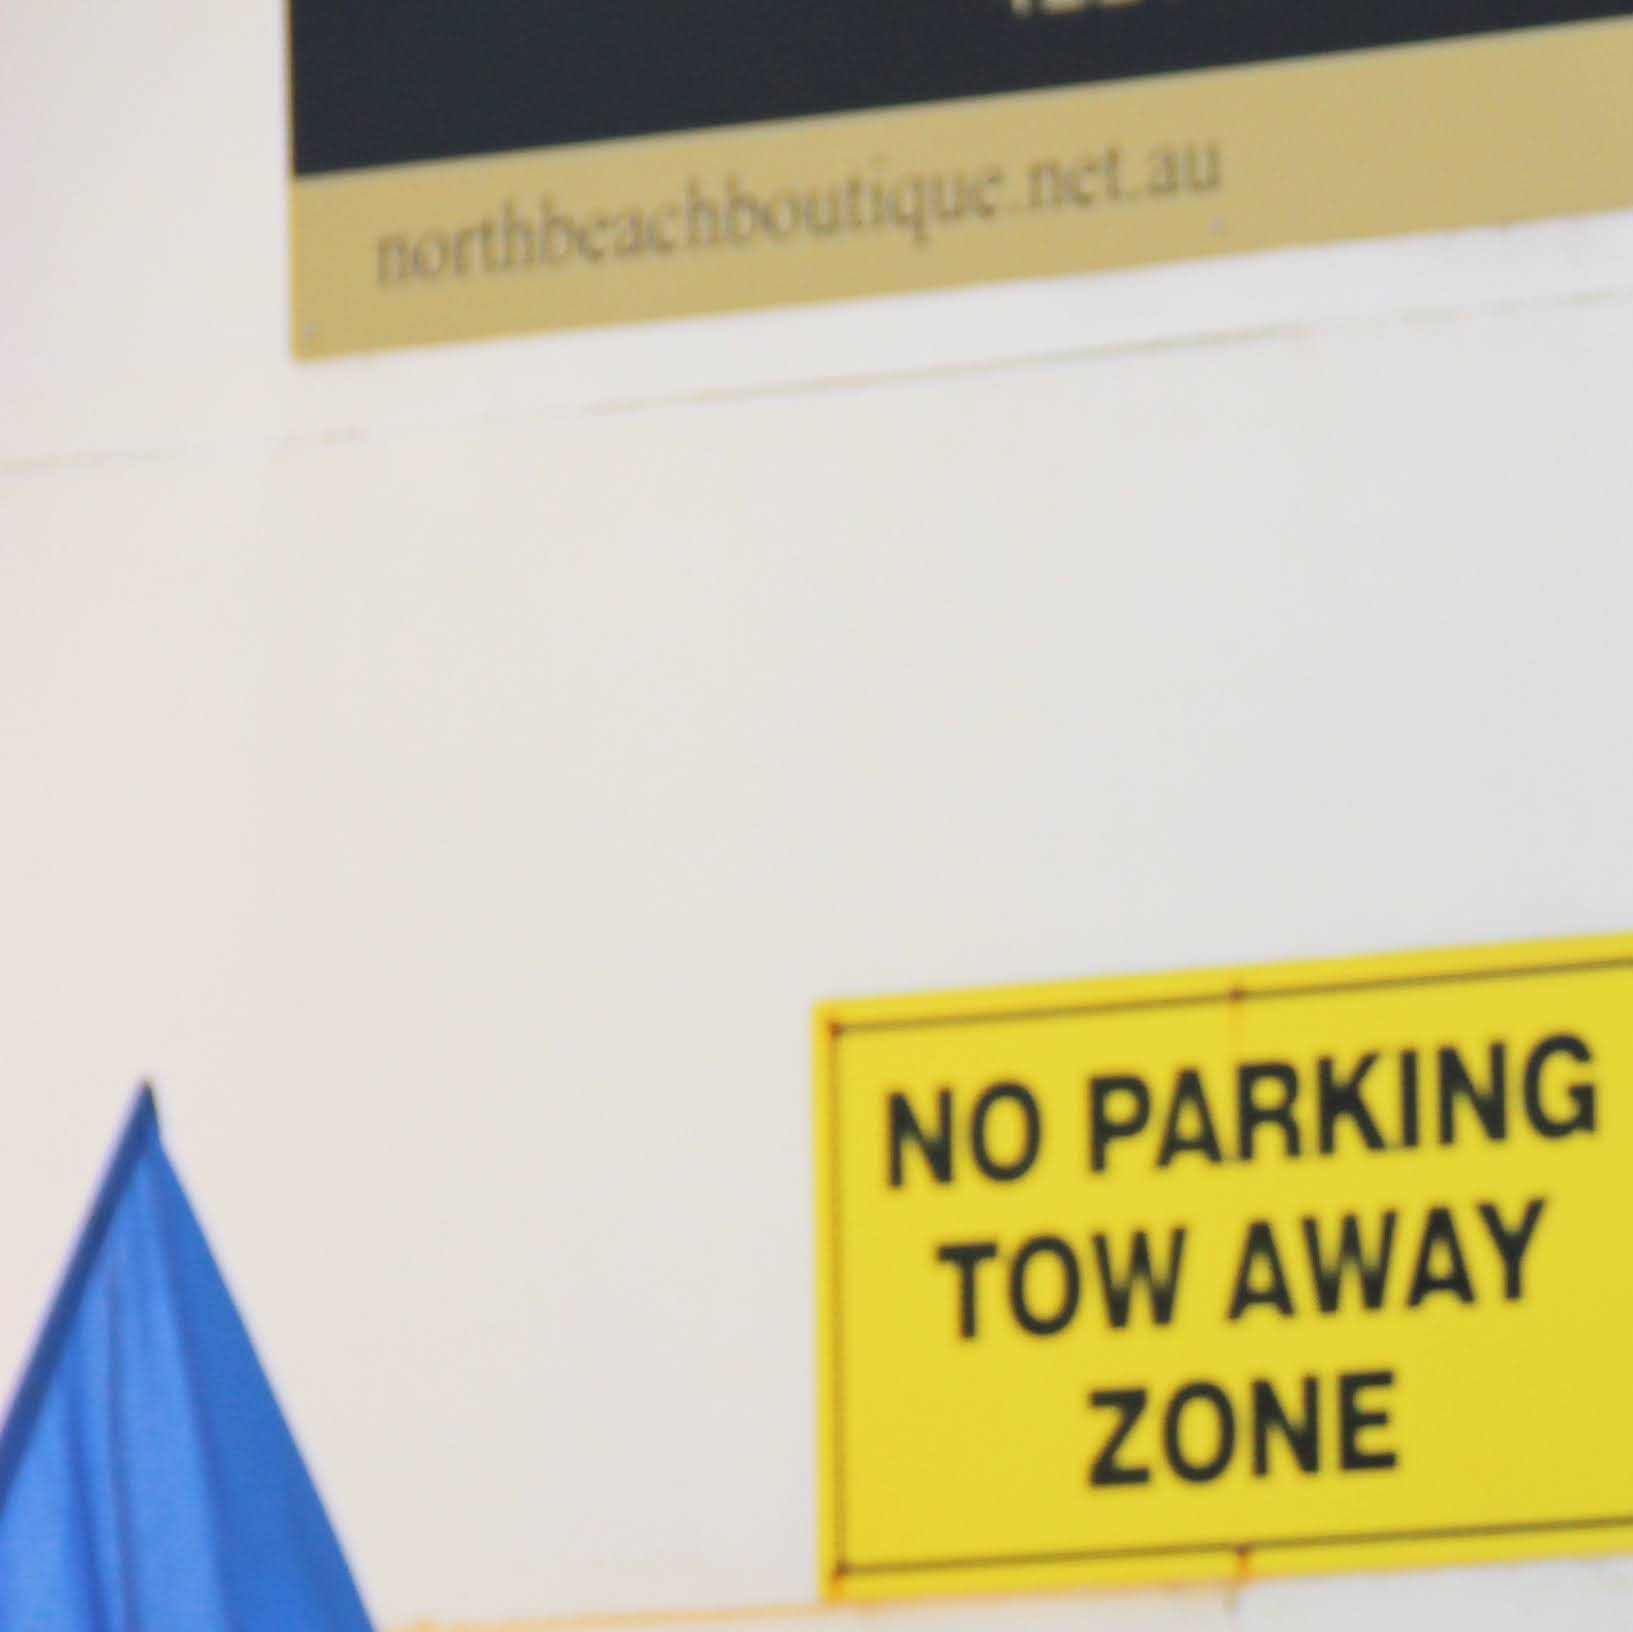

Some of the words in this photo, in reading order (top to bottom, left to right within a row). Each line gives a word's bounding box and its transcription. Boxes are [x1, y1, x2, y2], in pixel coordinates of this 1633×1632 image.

[375, 138, 1221, 286] northbeachboutique.net.au
[886, 1080, 1042, 1189] NO
[1087, 1033, 1598, 1174] PARKING
[936, 1226, 1187, 1340] TOW
[1227, 1197, 1547, 1323] AWAY
[1087, 1368, 1399, 1489] ZONE
